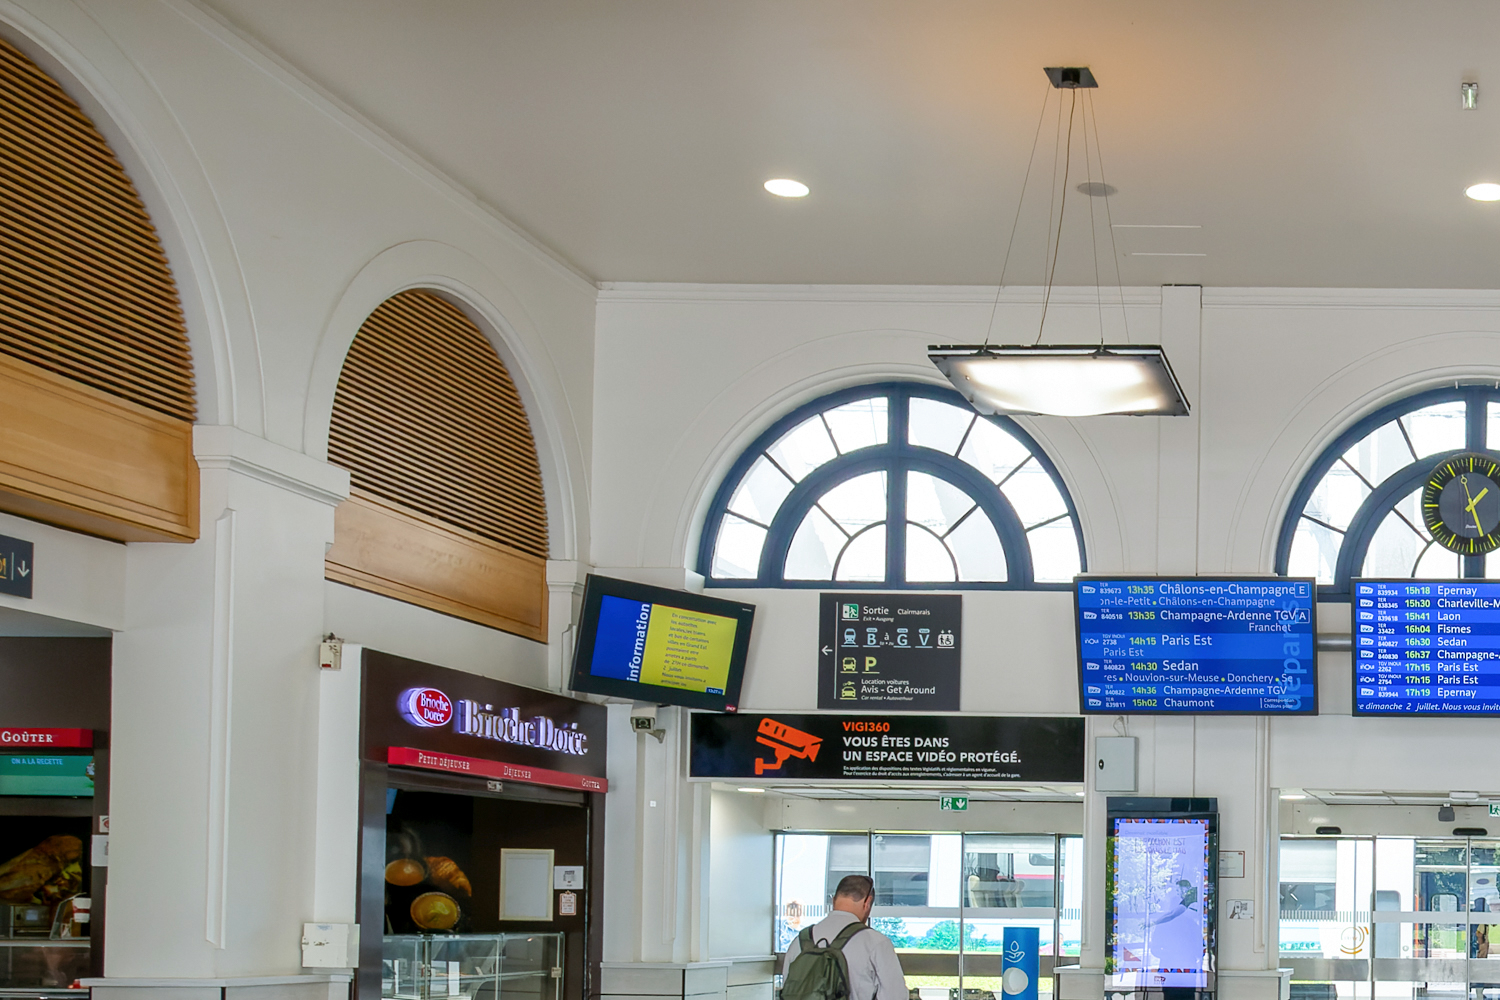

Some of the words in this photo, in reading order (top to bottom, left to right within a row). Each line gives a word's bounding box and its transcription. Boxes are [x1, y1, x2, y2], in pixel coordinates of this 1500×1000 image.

[1127, 585, 1155, 594] 13h35
[1159, 583, 1295, 597] Châlons-en-Champagne
[1299, 585, 1306, 594] E
[1405, 586, 1431, 595] 15h18
[1437, 585, 1477, 597] Epernay
[1158, 596, 1275, 608] Châlons-en-Champagne
[1405, 599, 1431, 608] 15h30
[863, 605, 889, 615] Sortie
[897, 608, 931, 616] Clairmarais
[1128, 611, 1156, 620] 13h35
[1160, 610, 1271, 622] Champagne-Ardenne
[1274, 610, 1296, 620] TGV
[1299, 611, 1306, 620] A
[1405, 612, 1431, 621] 15h41
[1437, 611, 1461, 621] Laon
[1249, 622, 1292, 632] Franchet
[1405, 625, 1431, 634] 16h04
[1437, 624, 1471, 634] Fismes
[626, 603, 650, 682] information
[867, 633, 877, 646] B
[884, 632, 890, 641] à
[897, 633, 908, 646] G
[919, 633, 930, 646] V
[1129, 636, 1156, 645] 14h15
[1161, 634, 1190, 646] Paris
[1193, 634, 1212, 646] Est
[1405, 637, 1431, 646] 16h30
[1437, 636, 1467, 646] Sedan
[1103, 647, 1127, 657] Paris
[1129, 647, 1144, 657] Est
[1405, 650, 1431, 659] 16h37
[865, 656, 877, 672] P
[1130, 661, 1158, 671] 14h30
[1162, 659, 1199, 671] Sedan
[1405, 663, 1431, 672] 17h15
[1437, 662, 1461, 672] Paris
[1463, 662, 1479, 672] Est
[1125, 672, 1219, 682] Nouvion-sur-Meuse
[1227, 672, 1274, 684] Donchery
[1405, 676, 1431, 684] 17h15
[1437, 675, 1461, 684] Paris
[1463, 675, 1479, 684] Est
[861, 685, 879, 694] Avis
[886, 685, 903, 694] Get
[904, 686, 936, 695] Around
[1132, 686, 1157, 695] 14h36
[1163, 685, 1265, 697] Champagne-Ardenne
[1267, 685, 1287, 695] TGV
[1405, 688, 1431, 697] 17h19
[1437, 687, 1477, 698] Epernay
[420, 693, 449, 713] Brioche
[1132, 698, 1158, 707] 15h02
[1163, 697, 1215, 707] Chaumont
[1365, 702, 1403, 711] dimanche
[1405, 702, 1412, 710] 2
[1442, 702, 1462, 710] Nous
[459, 700, 534, 746] Brioche
[842, 721, 890, 732] VIGI360
[1, 730, 53, 743] GOÛTER
[842, 736, 878, 747] VOUS
[881, 734, 911, 747] ÊTES
[914, 737, 949, 748] DANS
[842, 750, 862, 761] UN
[865, 751, 913, 762] ESPACE
[917, 750, 956, 762] VIDÉO
[960, 750, 1022, 763] PROTÉGÉ.
